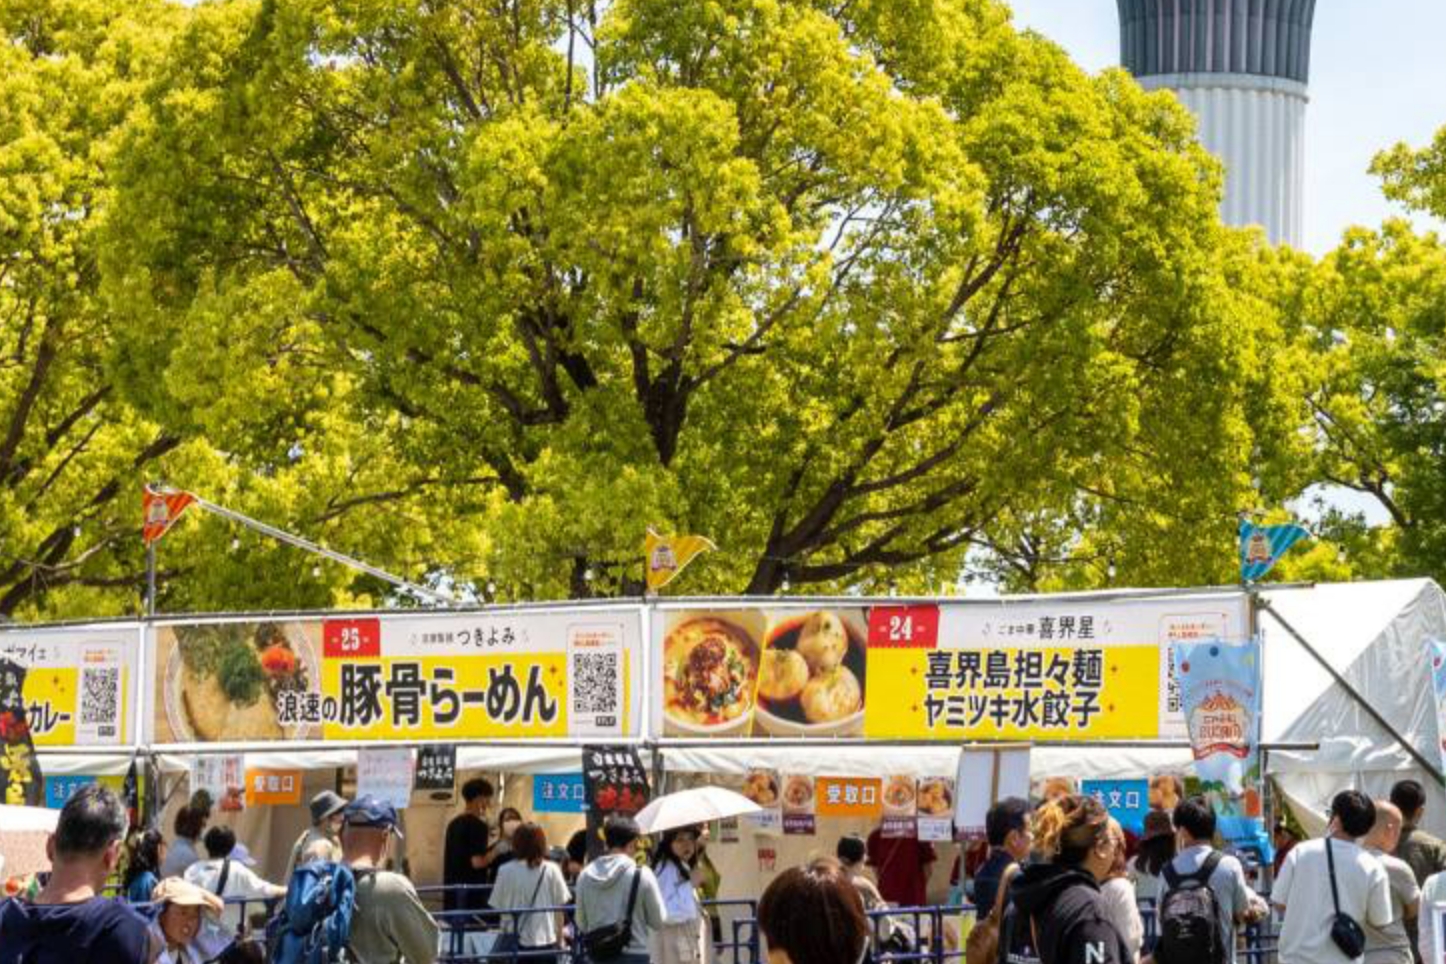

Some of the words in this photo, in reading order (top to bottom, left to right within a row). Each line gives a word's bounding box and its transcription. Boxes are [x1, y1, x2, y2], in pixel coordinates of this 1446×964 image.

[341, 627, 359, 650] 25
[457, 627, 516, 646] つきよみ
[888, 616, 913, 640] 24
[1039, 616, 1095, 639] 喜界星
[925, 648, 1102, 690] 喜界島担々麺
[278, 663, 557, 727] 浪速の豚骨らーめん
[924, 691, 1101, 728] ヤミツキ水餃子
[541, 781, 584, 799] 注文口
[827, 785, 875, 805] 受取口
